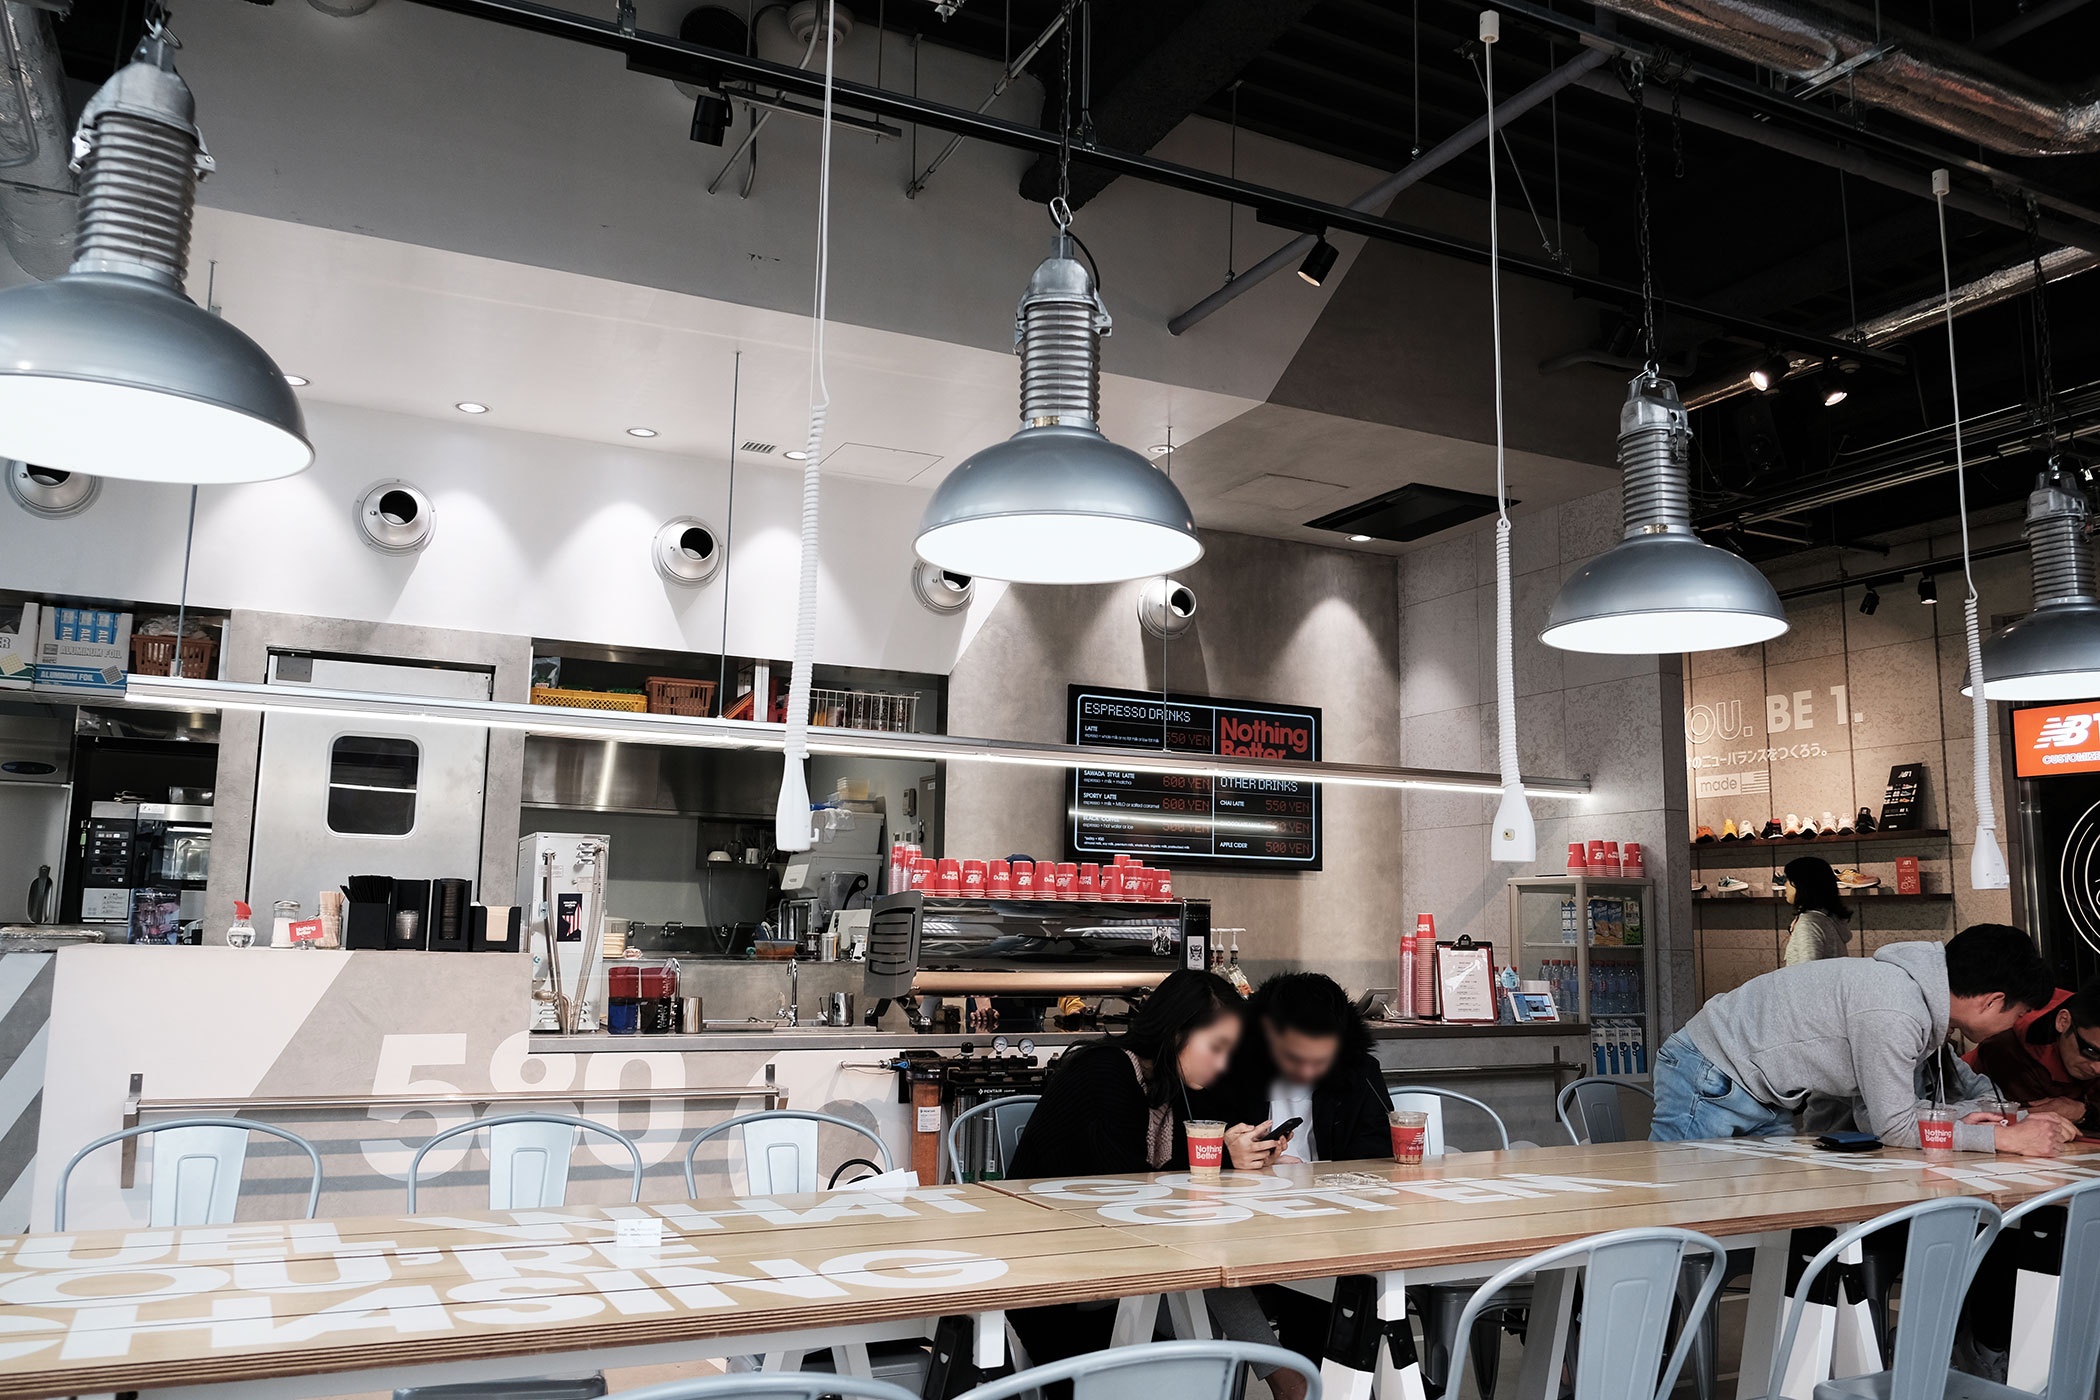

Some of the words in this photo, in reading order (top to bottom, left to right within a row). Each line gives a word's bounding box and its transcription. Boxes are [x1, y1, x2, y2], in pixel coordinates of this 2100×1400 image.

[60, 646, 104, 657] ALUMINUM
[104, 649, 122, 659] FOIL
[1084, 702, 1146, 719] ESPRESSO
[1148, 708, 1191, 723] DRINKS
[1766, 690, 1814, 734] BE
[1830, 685, 1864, 725] 1.
[1188, 733, 1210, 746] YEN
[1220, 717, 1308, 753] Nothing
[1162, 776, 1186, 788] 600
[1187, 777, 1210, 790] YEN
[1220, 776, 1257, 789] OTHER
[1258, 778, 1298, 792] DRINKS
[1700, 777, 1738, 793] made
[1162, 798, 1185, 810] 600
[1187, 799, 1210, 812] YEN
[1265, 800, 1286, 811] 550
[1289, 801, 1309, 813] YEN
[1289, 822, 1309, 834] YEN
[1265, 842, 1286, 853] 500
[1289, 843, 1309, 854] YEN
[360, 1030, 686, 1182] 580
[1923, 1128, 1952, 1138] Nothing
[1925, 1135, 1947, 1143] Better
[1195, 1144, 1223, 1155] Nothing
[1196, 1152, 1218, 1160] Better
[1028, 1172, 1294, 1202] GO
[0, 1222, 399, 1269] UEL
[0, 1231, 720, 1309] OU'RE
